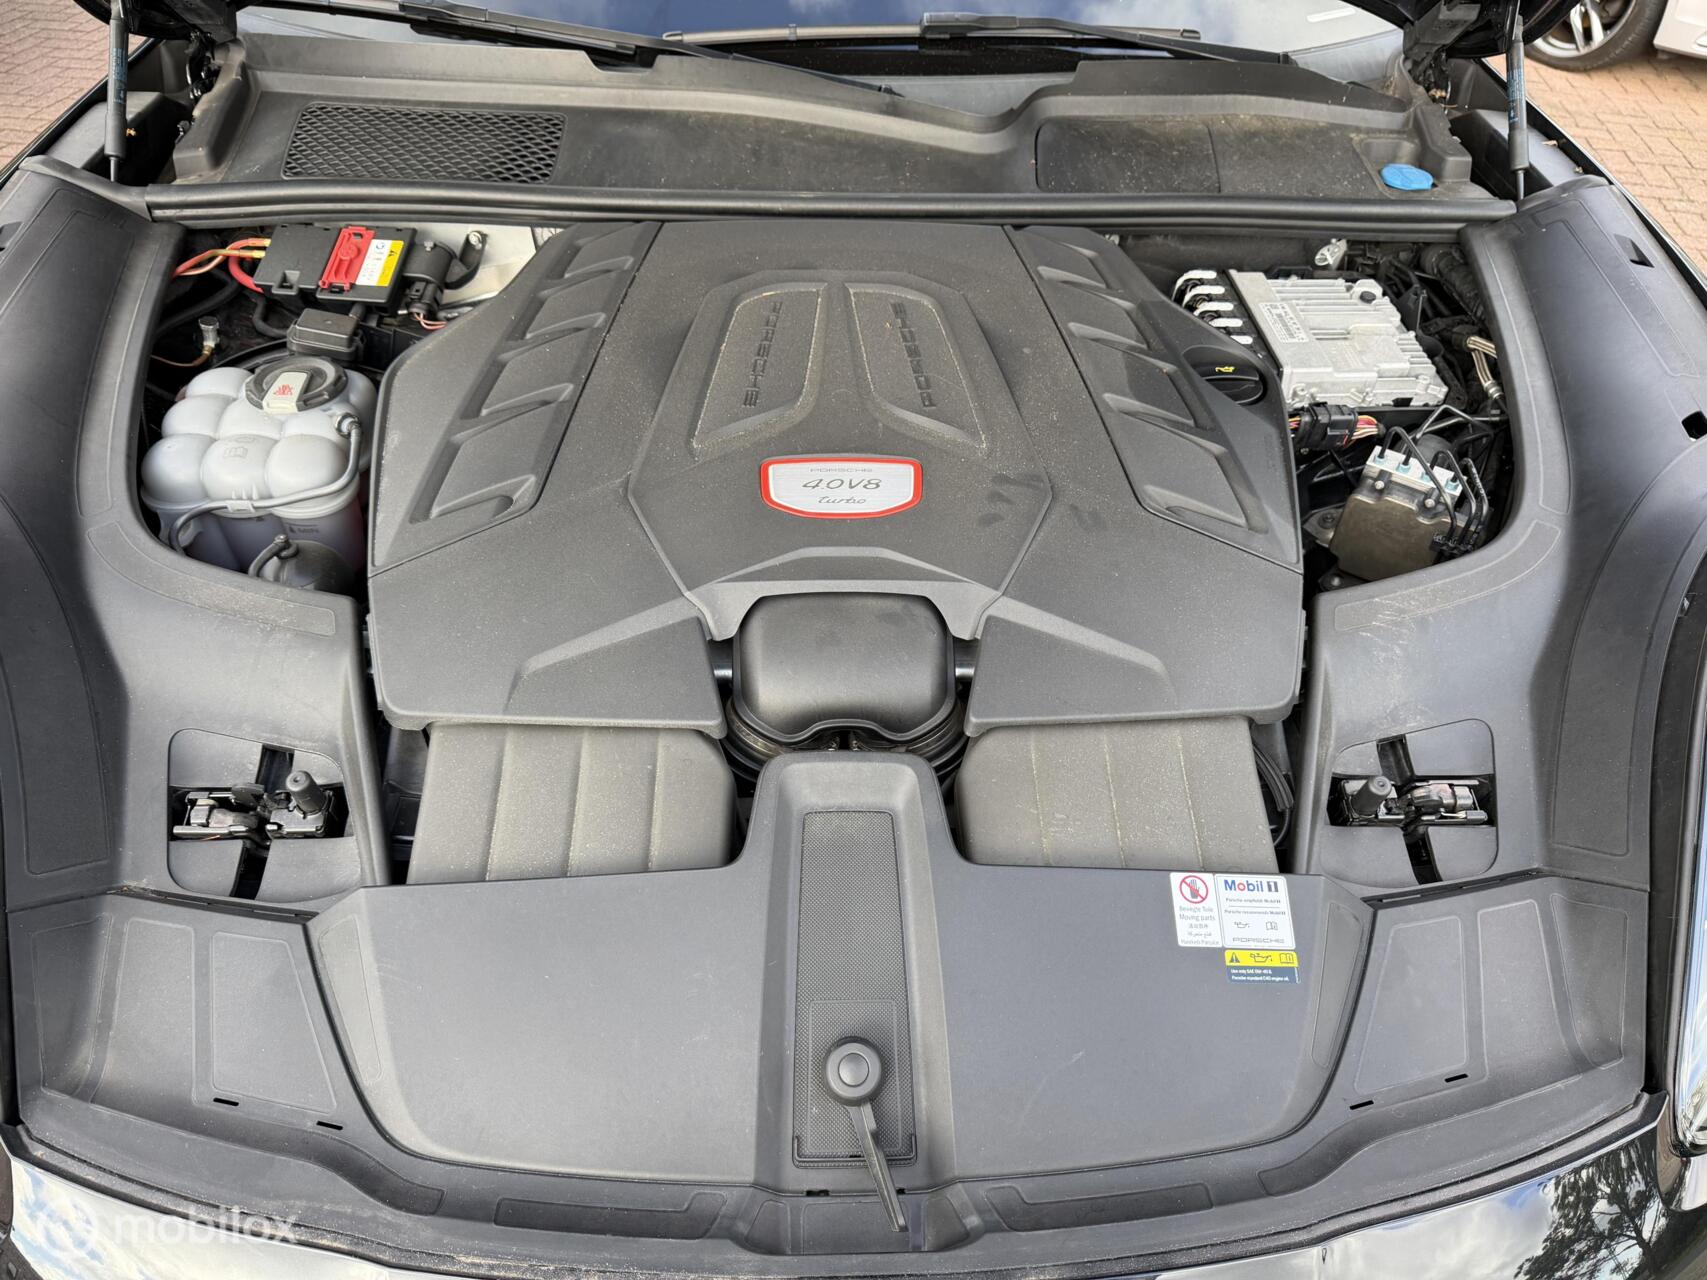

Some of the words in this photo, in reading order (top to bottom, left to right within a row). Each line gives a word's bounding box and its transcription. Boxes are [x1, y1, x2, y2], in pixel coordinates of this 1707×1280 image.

[818, 495, 867, 504] turbo
[1223, 879, 1264, 892] Mobil
[1179, 913, 1200, 922] Moving
[1201, 914, 1216, 922] parts
